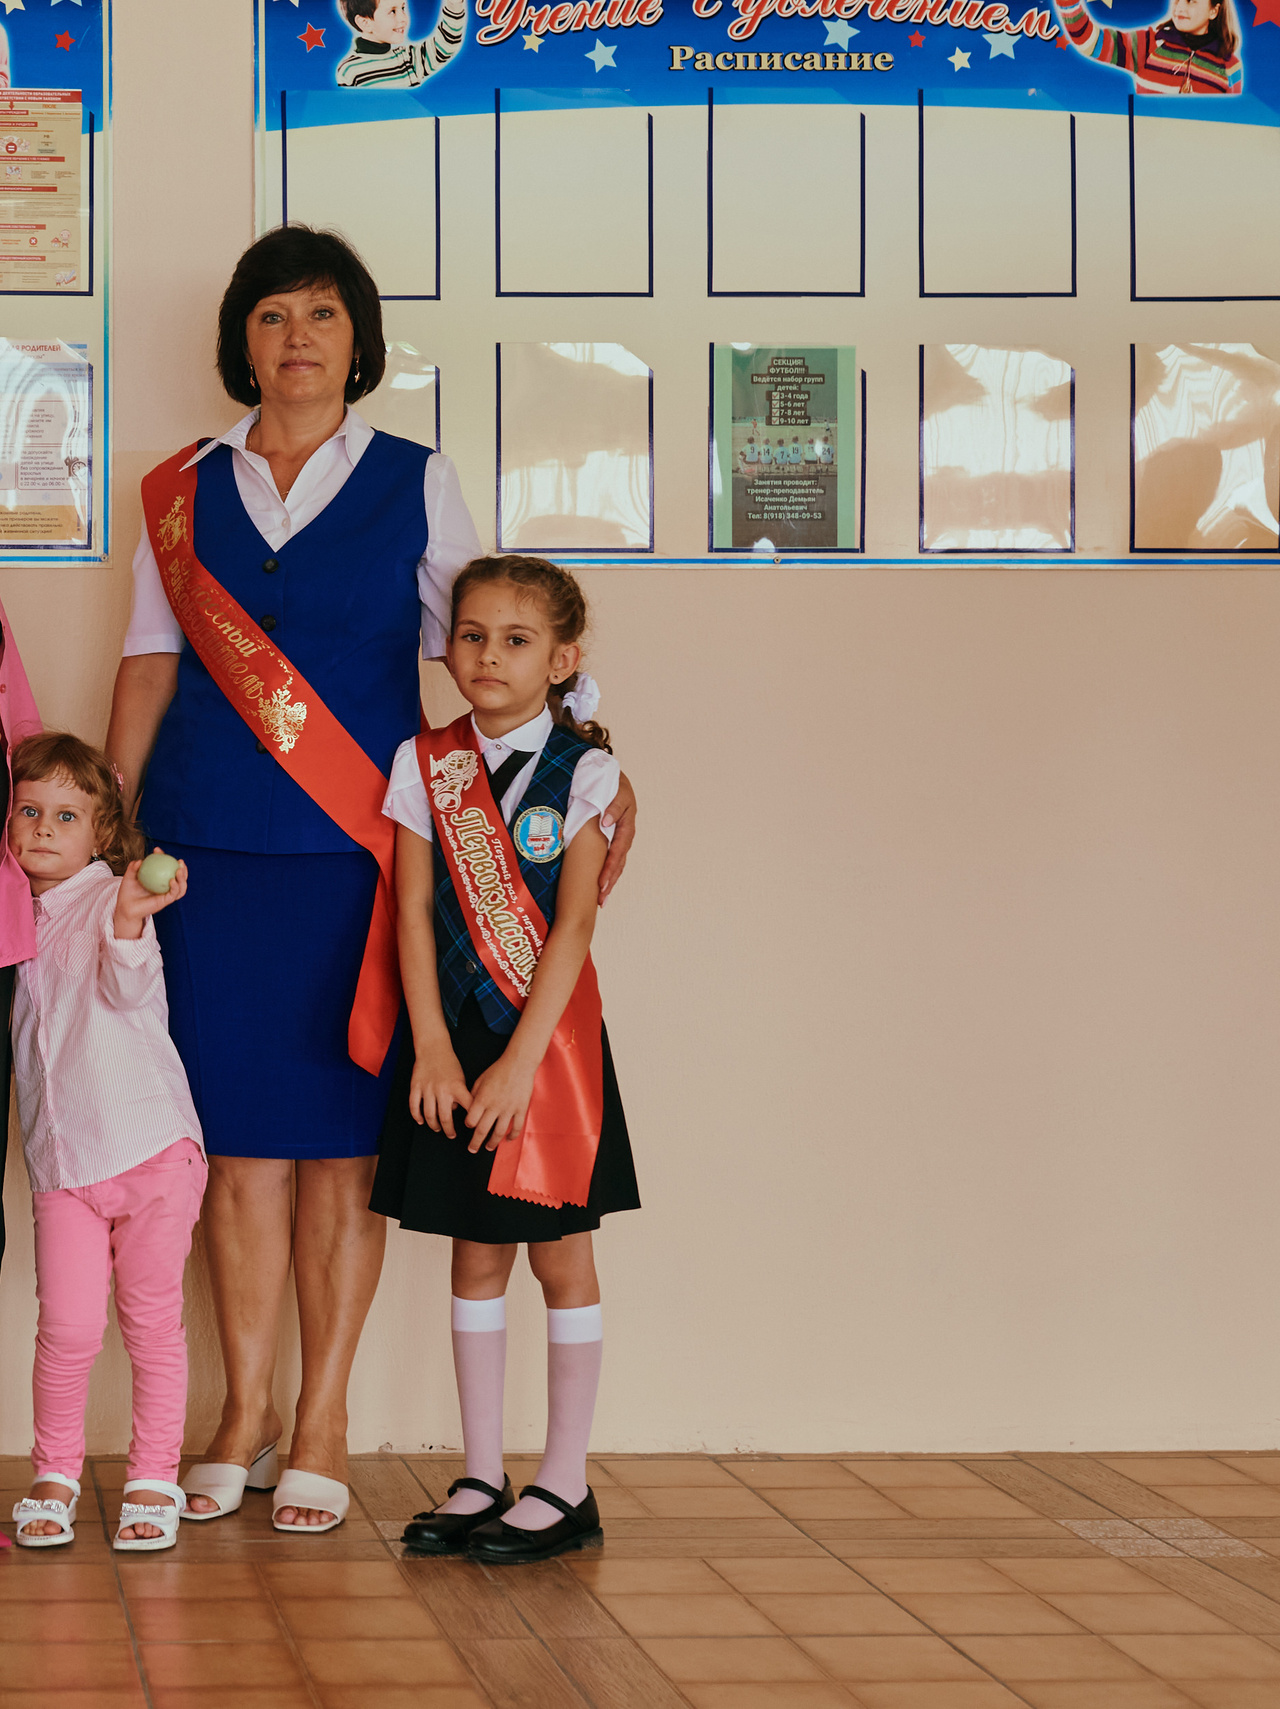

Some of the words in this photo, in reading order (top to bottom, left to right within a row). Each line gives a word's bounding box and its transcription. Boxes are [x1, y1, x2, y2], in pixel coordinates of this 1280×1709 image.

[669, 46, 894, 71] Расписание
[21, 344, 61, 352] РОДИТЕЛЕЙ
[753, 375, 781, 383] Ведётся
[783, 375, 803, 384] набор
[822, 447, 831, 455] 24
[763, 512, 786, 520] 8(918)
[491, 838, 512, 884] Первый
